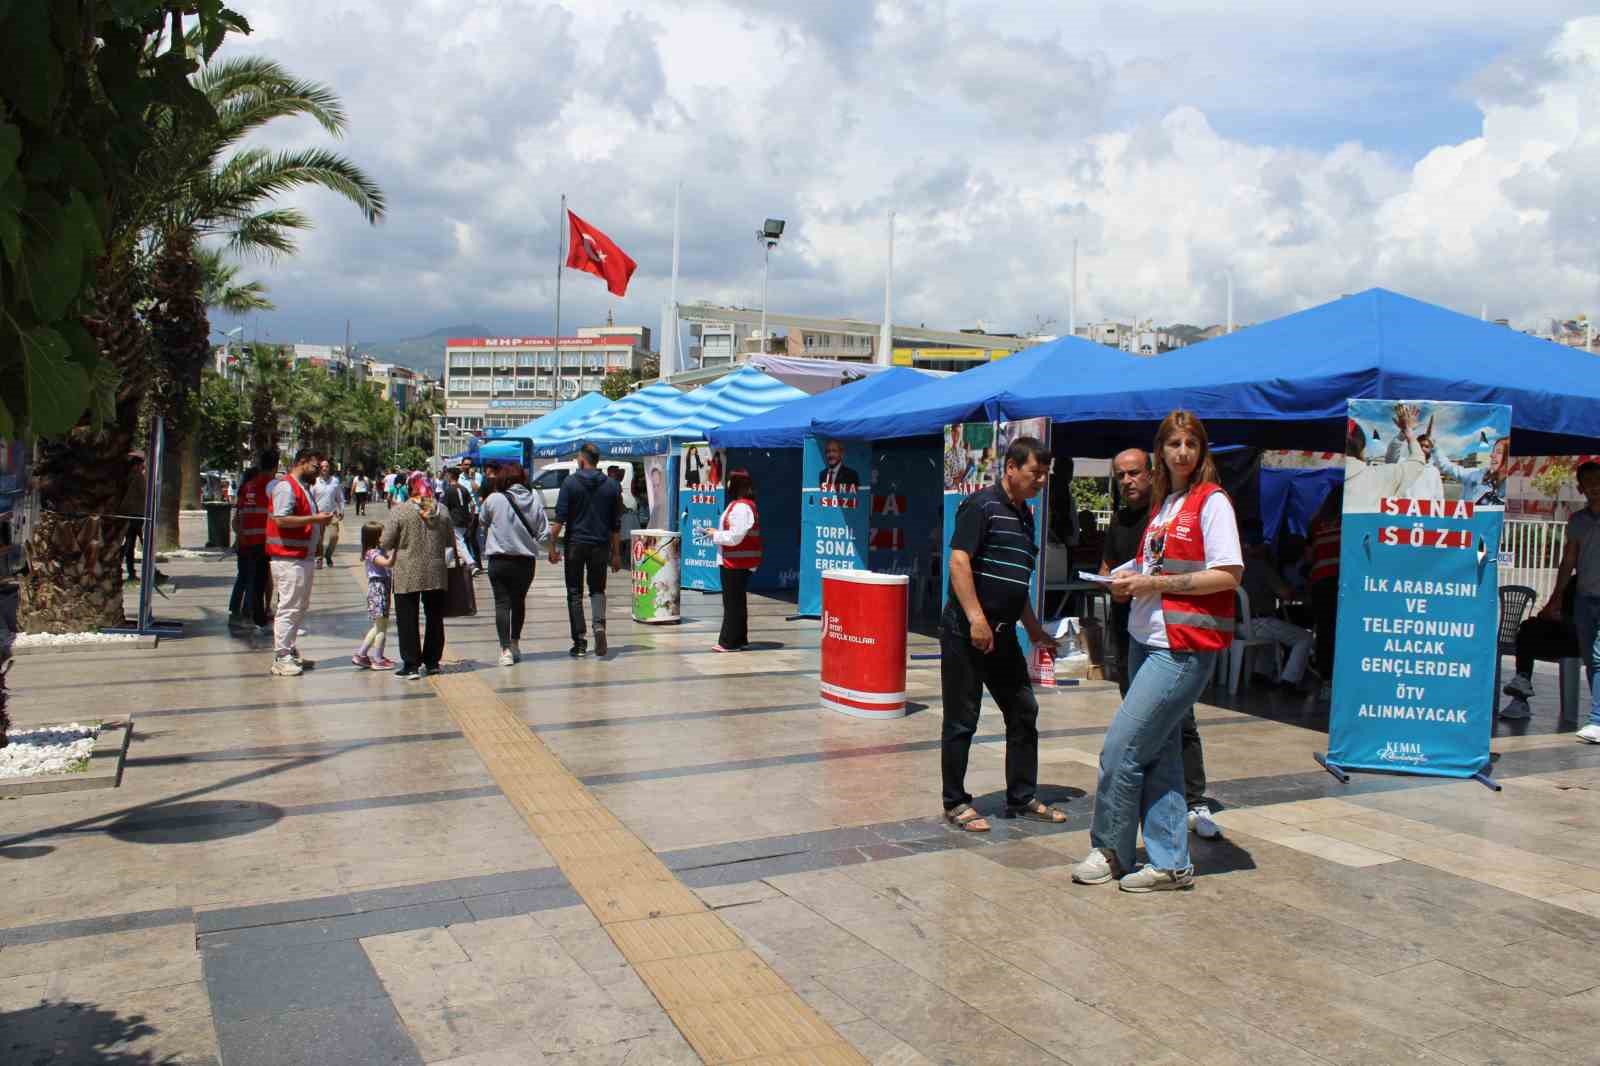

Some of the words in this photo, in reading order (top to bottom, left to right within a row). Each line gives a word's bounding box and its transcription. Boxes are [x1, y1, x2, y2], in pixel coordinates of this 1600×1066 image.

[485, 338, 522, 346] MHP
[821, 482, 857, 494] SANA
[821, 495, 857, 509] SÖZ!
[1385, 496, 1469, 520] SANA
[815, 525, 857, 540] TORPİL
[1383, 522, 1467, 550] SÖZ!
[815, 540, 856, 557] SONA
[815, 558, 855, 571] ERECEK
[1363, 575, 1389, 593] İLK
[1392, 578, 1478, 598] ARABASINI
[1405, 598, 1428, 614] VE
[1362, 617, 1475, 638] TELEFONUNU
[1383, 638, 1446, 655] ALACAK
[1361, 657, 1472, 679] GENÇLERDEN
[1395, 682, 1425, 701] ÖTV
[1358, 703, 1468, 724] ALINMAYACAK
[1385, 741, 1423, 754] KEMAL
